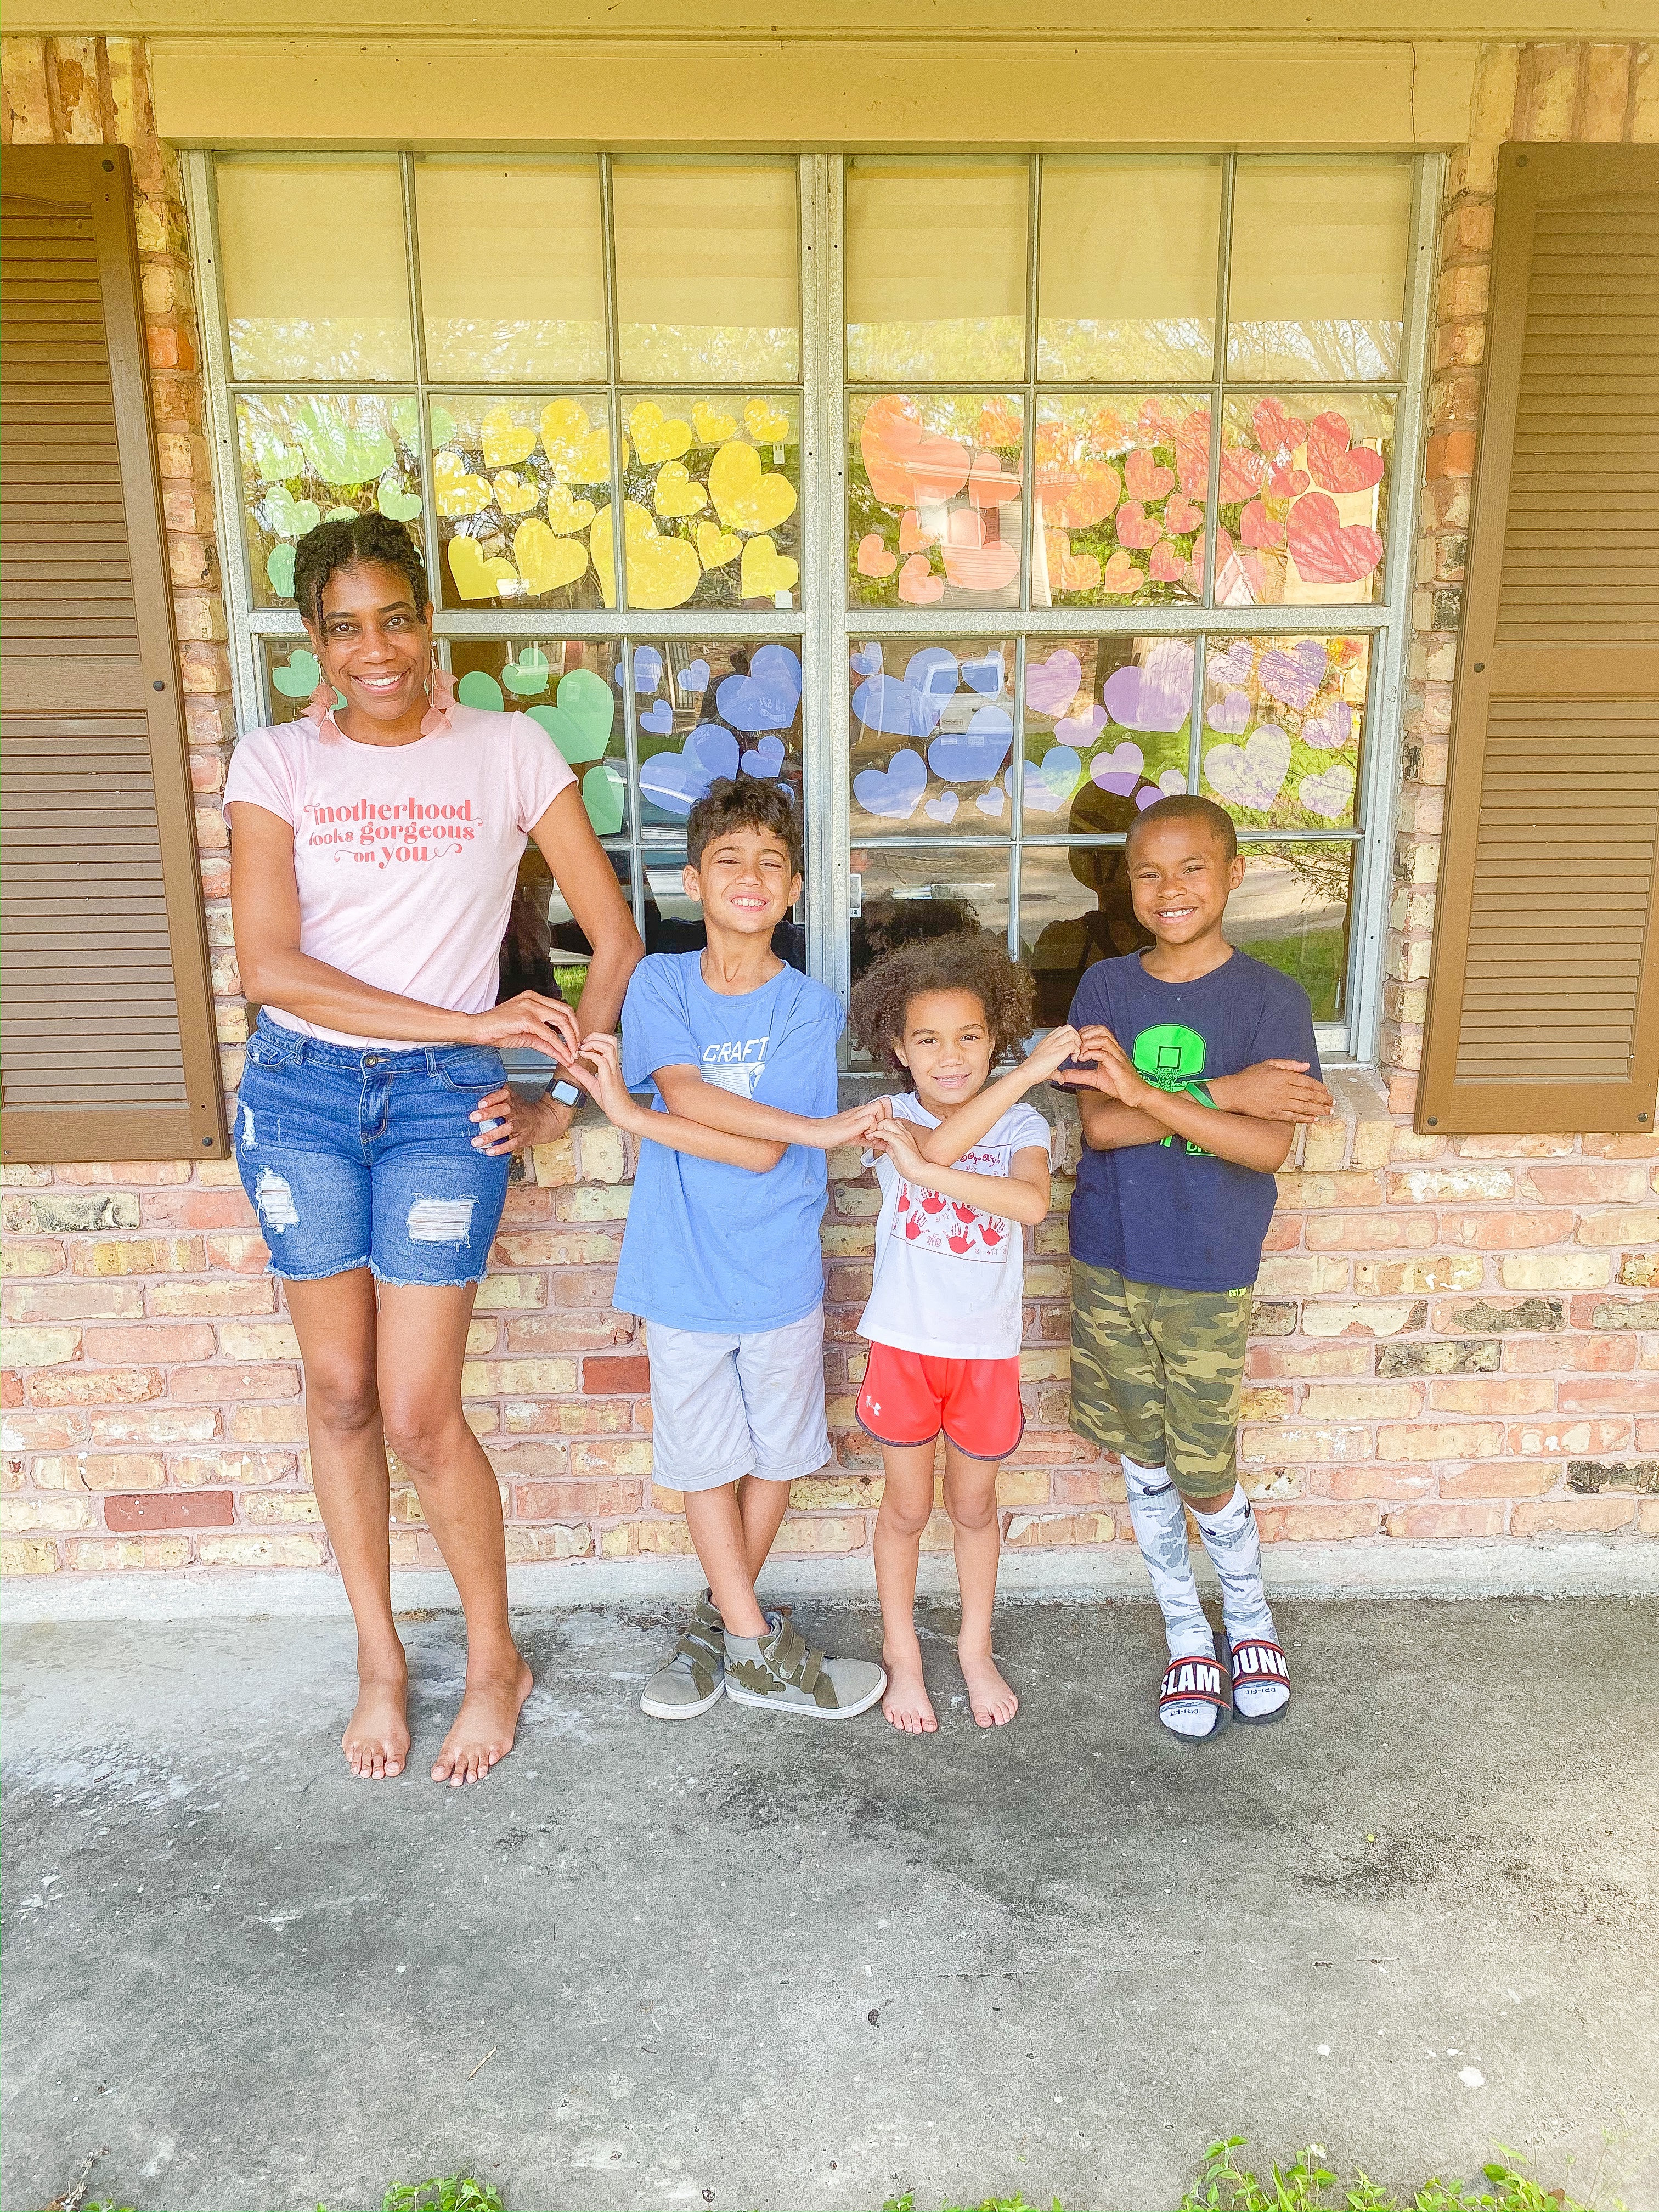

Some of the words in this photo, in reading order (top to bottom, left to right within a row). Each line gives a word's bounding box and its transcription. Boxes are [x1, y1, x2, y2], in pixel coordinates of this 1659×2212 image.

[304, 797, 483, 826] motherhood
[309, 828, 354, 845] looks
[359, 822, 475, 845] gorgeous
[379, 843, 462, 869] you
[702, 1036, 769, 1062] CRAFT
[1169, 1708, 1199, 1717] DRI-FIT
